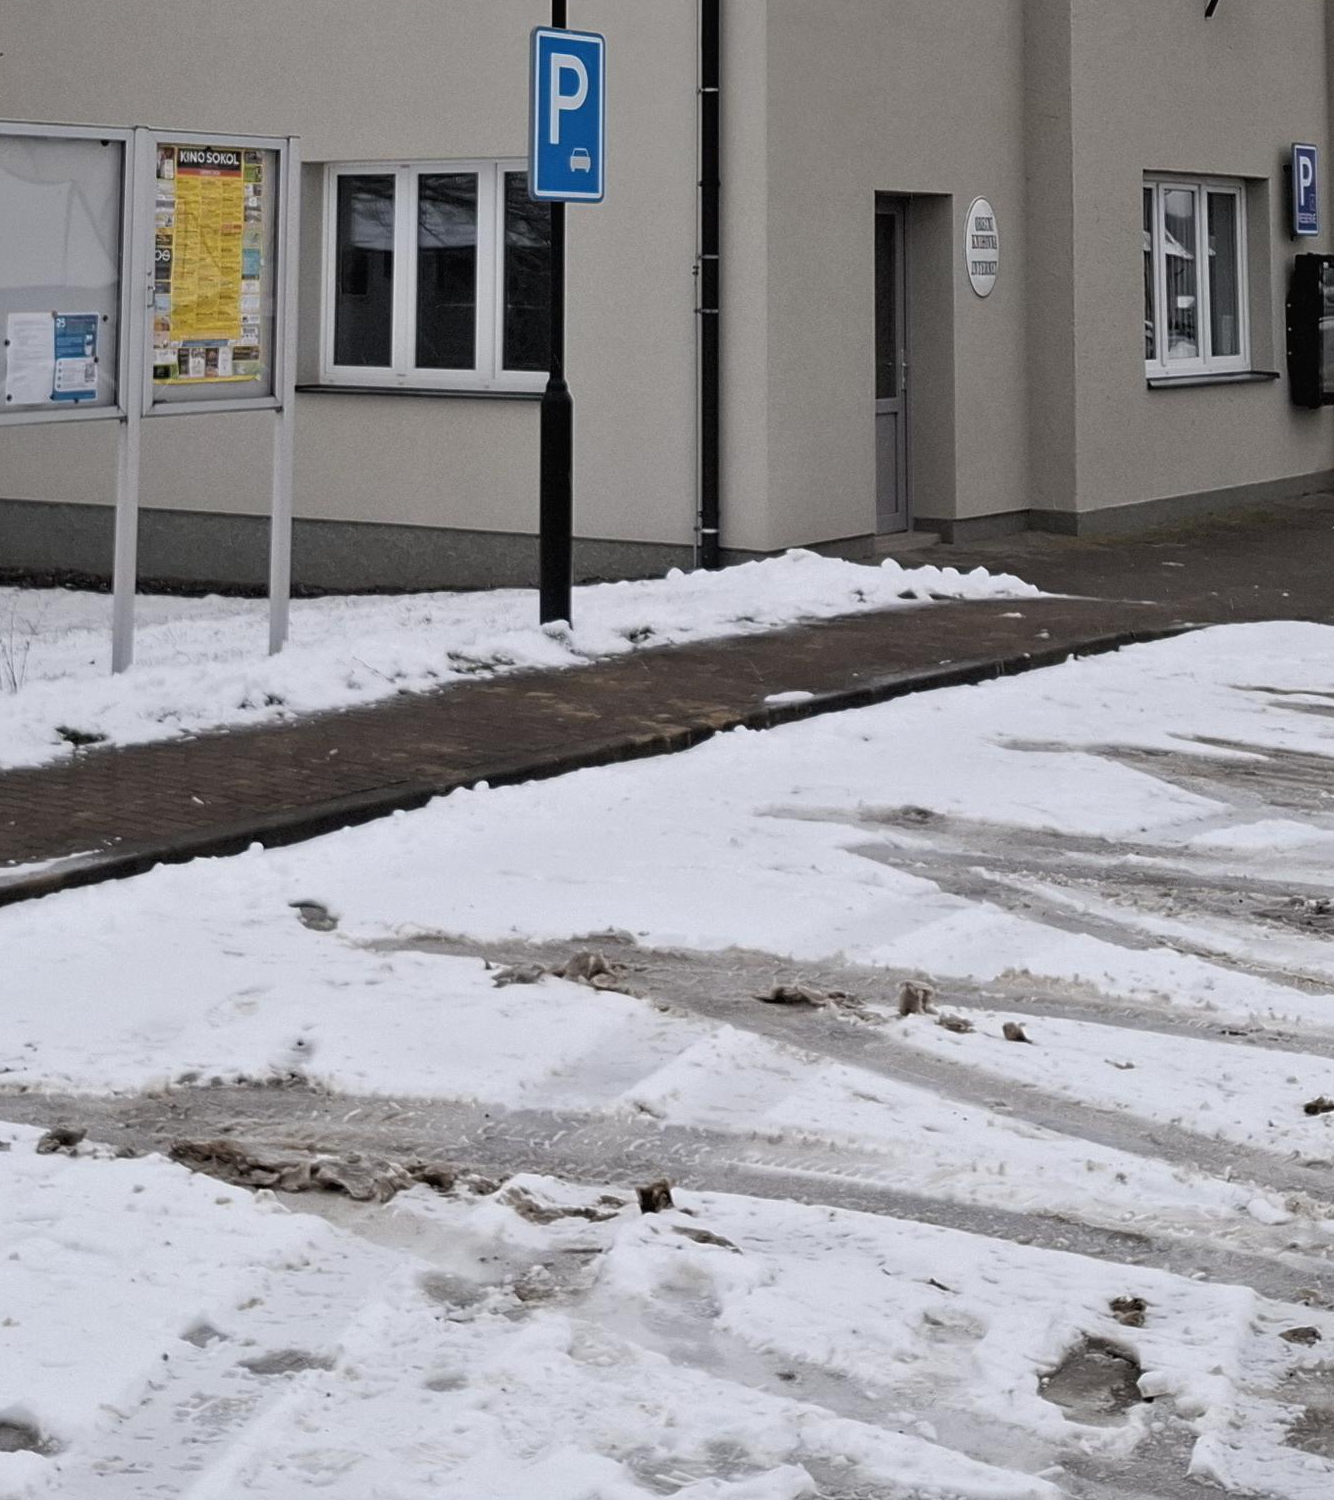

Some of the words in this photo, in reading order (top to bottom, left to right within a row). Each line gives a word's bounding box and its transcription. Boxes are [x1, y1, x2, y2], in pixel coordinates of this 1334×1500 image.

[550, 52, 589, 144] P
[180, 150, 205, 163] KINO
[206, 152, 239, 165] SOKOL
[1299, 156, 1312, 206] P
